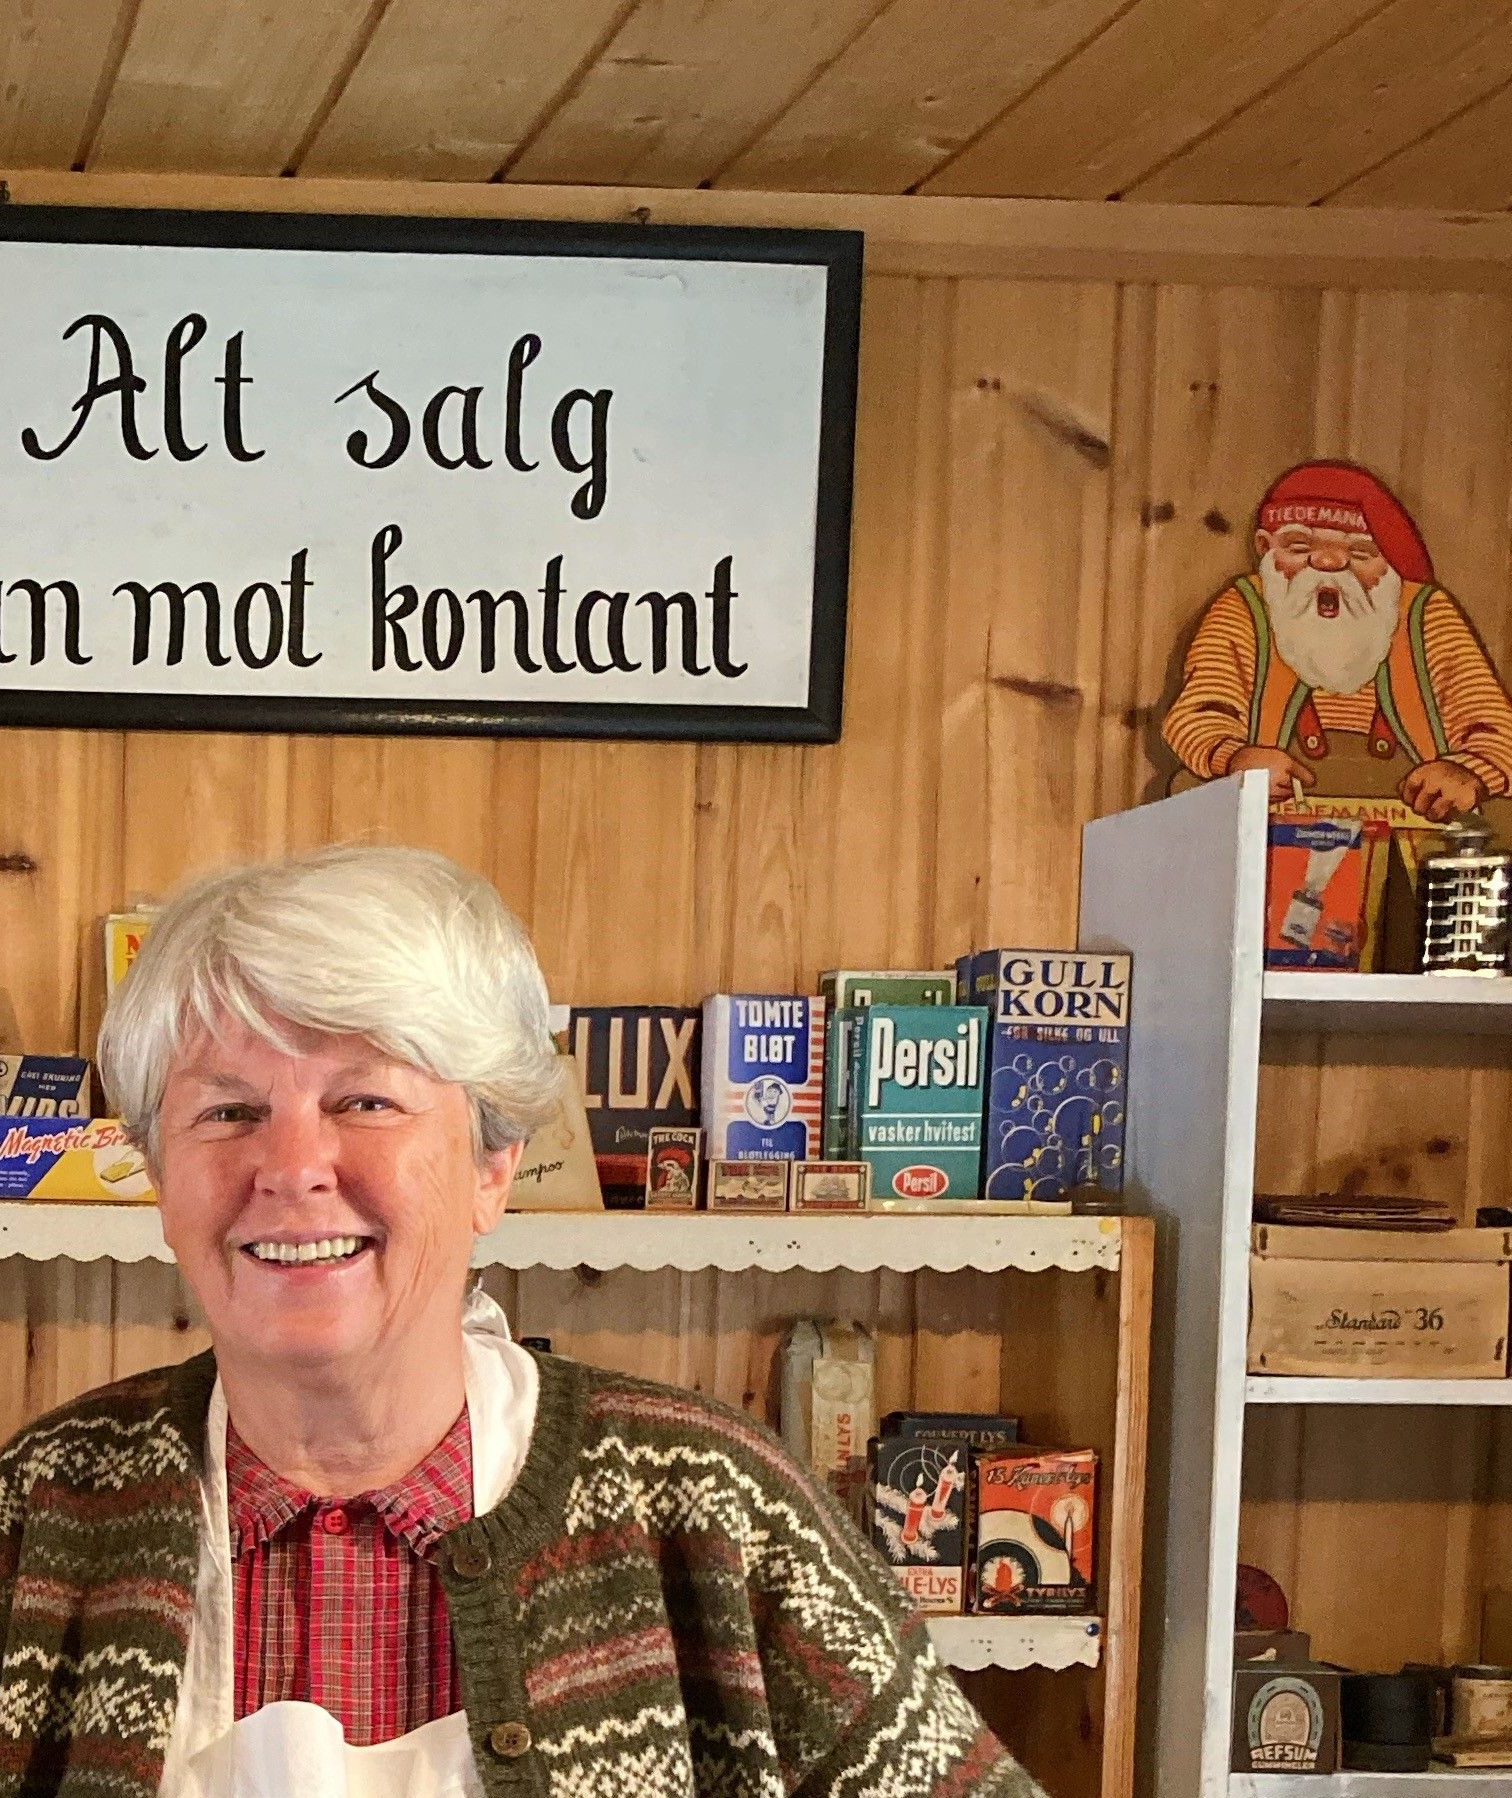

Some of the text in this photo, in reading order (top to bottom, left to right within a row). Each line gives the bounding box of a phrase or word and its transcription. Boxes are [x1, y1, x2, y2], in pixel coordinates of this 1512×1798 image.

[22, 312, 614, 520] Alt salg
[113, 548, 323, 669] mot
[372, 524, 747, 677] kontant
[1002, 958, 1125, 989] GULL
[735, 1000, 804, 1029] TOMTE
[1000, 989, 1125, 1019] KORN
[743, 1034, 796, 1063] BLØT
[1098, 1028, 1120, 1043] ULL
[574, 1016, 697, 1110] LUX
[868, 1017, 980, 1107] Persil
[868, 1120, 975, 1143] vasker hvitest
[902, 1172, 938, 1193] Persil
[1316, 1307, 1444, 1331] Standard 36
